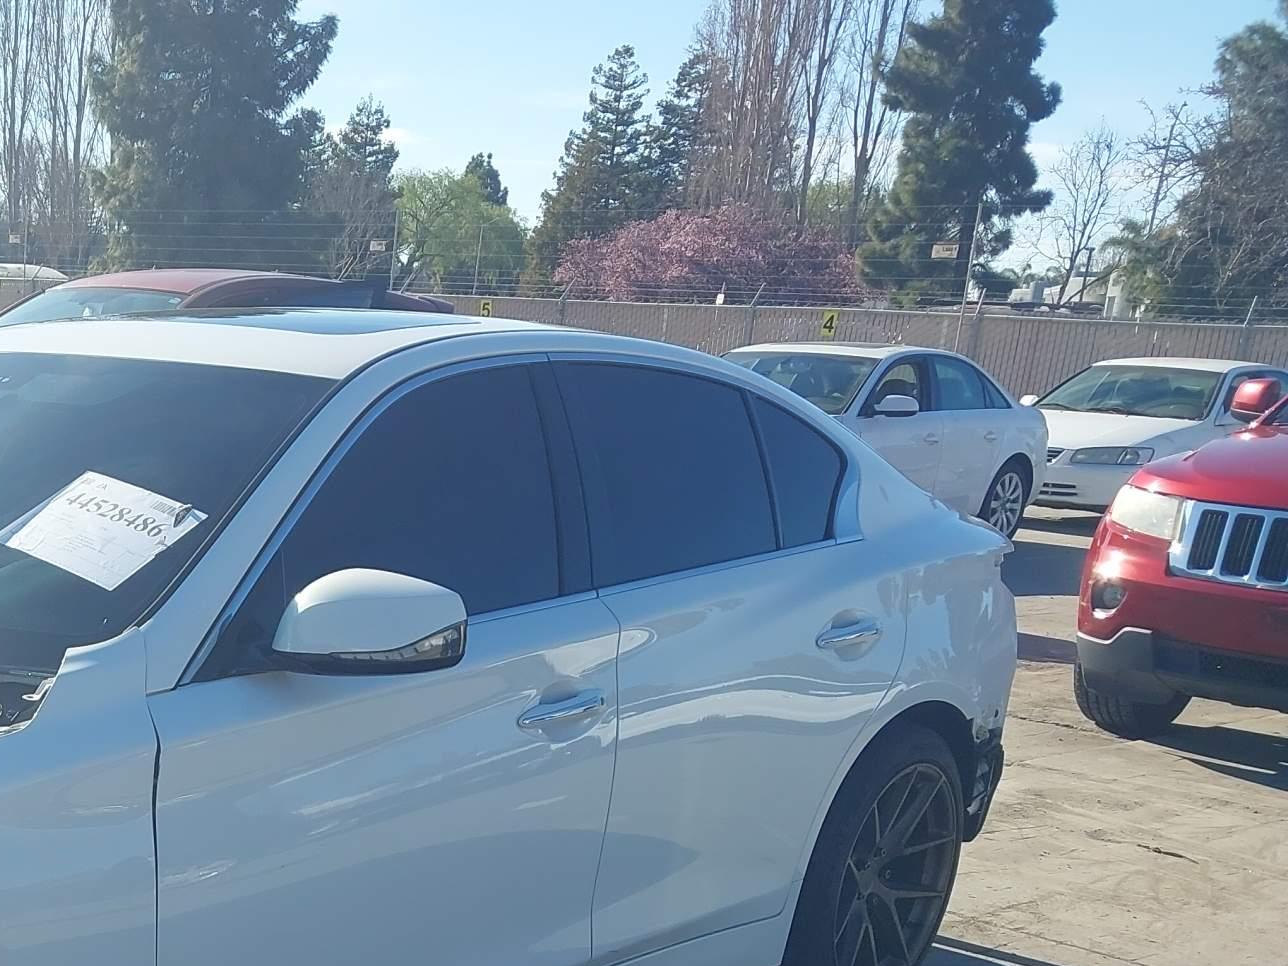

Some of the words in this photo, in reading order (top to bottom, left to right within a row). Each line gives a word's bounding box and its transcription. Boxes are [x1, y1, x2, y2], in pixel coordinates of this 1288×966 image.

[481, 302, 491, 318] 5
[822, 314, 835, 333] 4
[66, 492, 170, 537] 44528486
